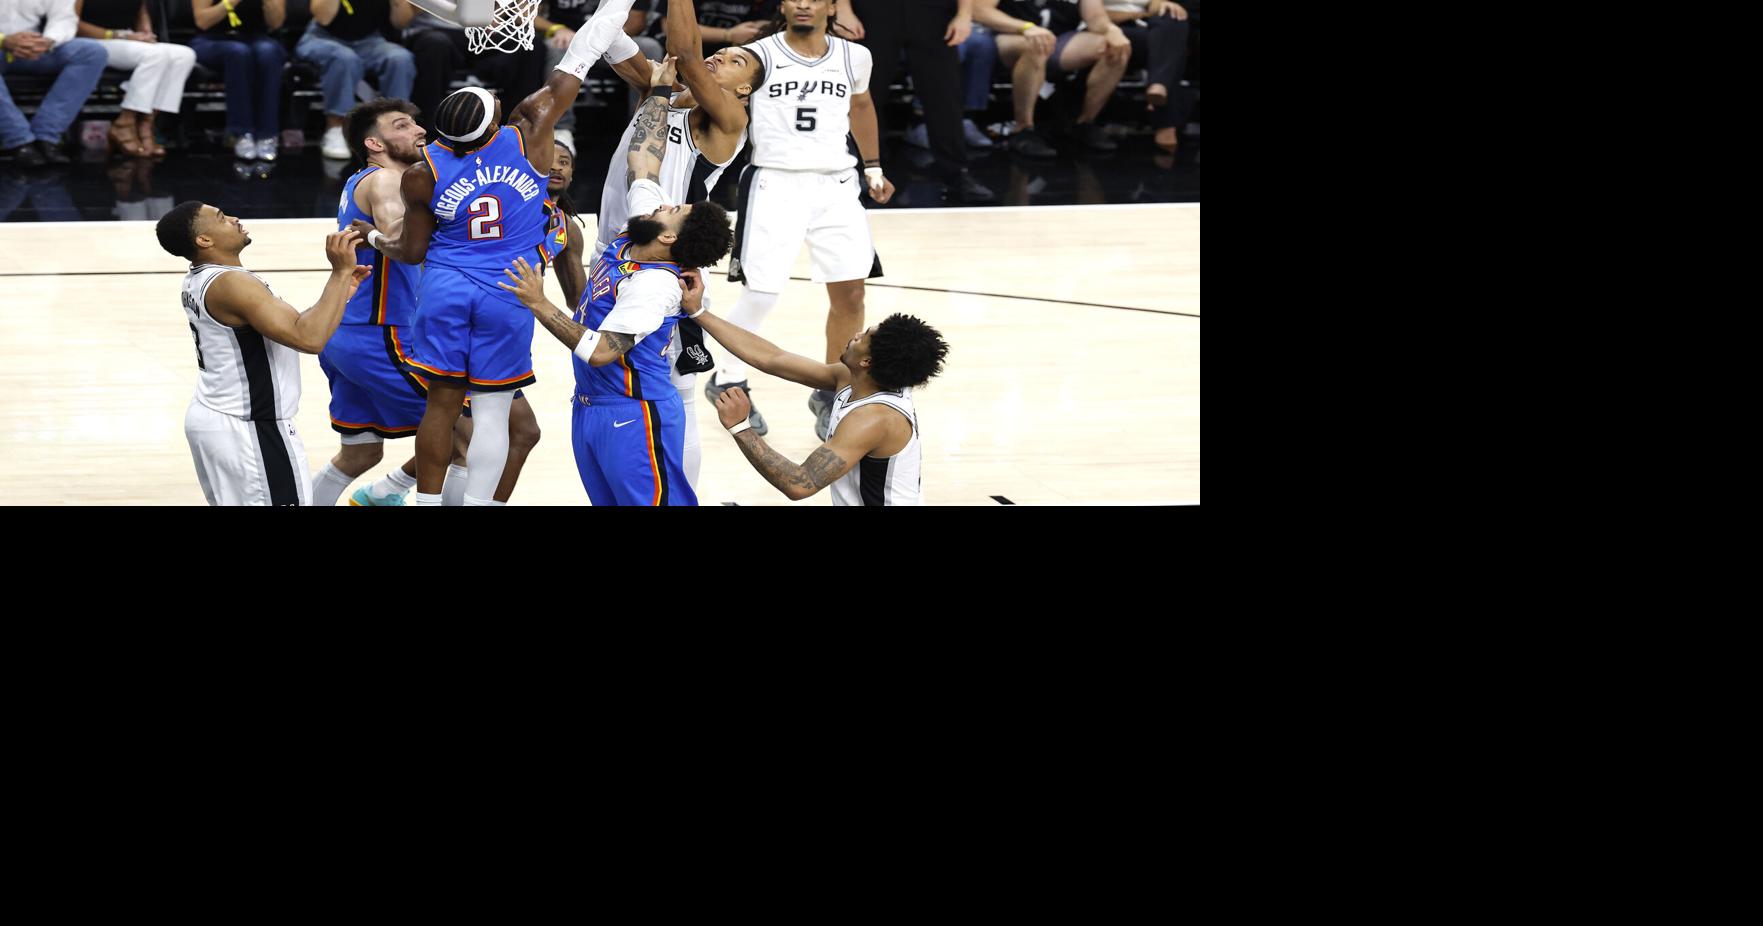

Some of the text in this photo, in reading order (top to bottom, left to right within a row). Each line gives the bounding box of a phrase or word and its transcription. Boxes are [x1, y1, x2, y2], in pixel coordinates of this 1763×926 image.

[769, 80, 847, 102] SPURS
[796, 107, 817, 132] 5
[468, 194, 503, 241] 2
